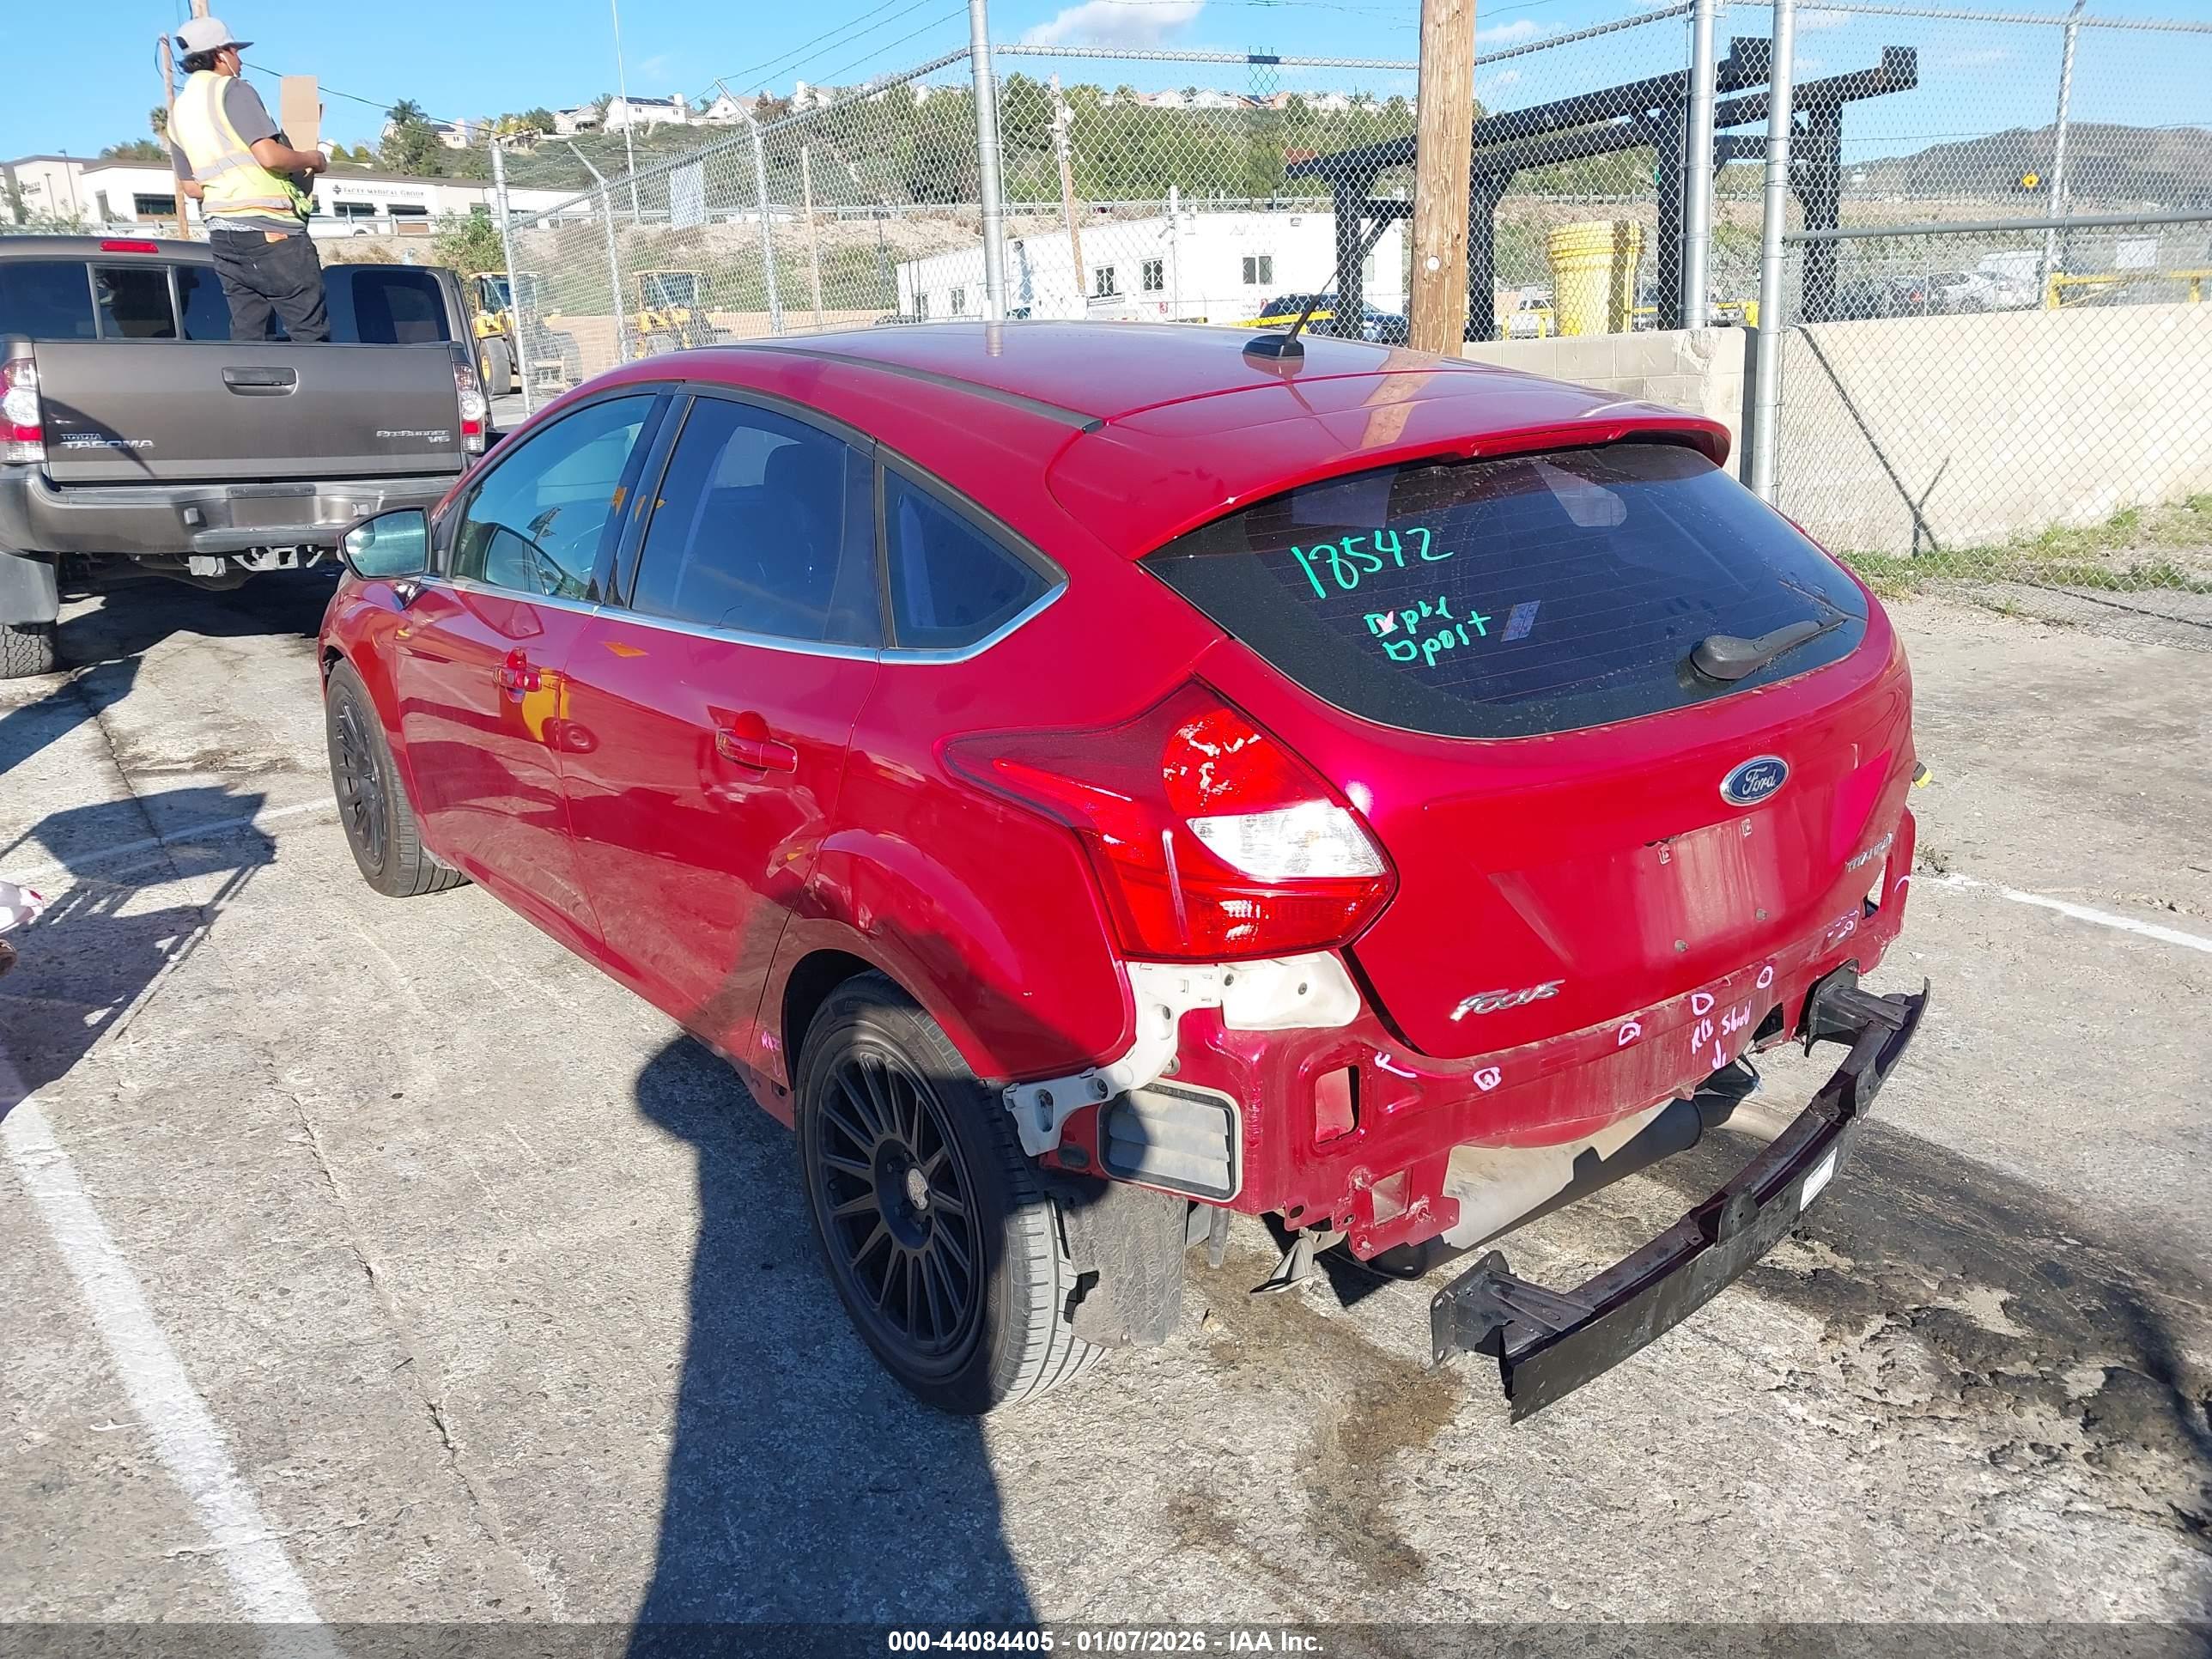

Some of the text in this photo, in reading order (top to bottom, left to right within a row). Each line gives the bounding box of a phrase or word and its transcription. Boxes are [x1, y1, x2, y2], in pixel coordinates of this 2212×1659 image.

[60, 440, 155, 449] TACOMA
[1291, 527, 1454, 599] 18542
[1741, 765, 1777, 795] Ford
